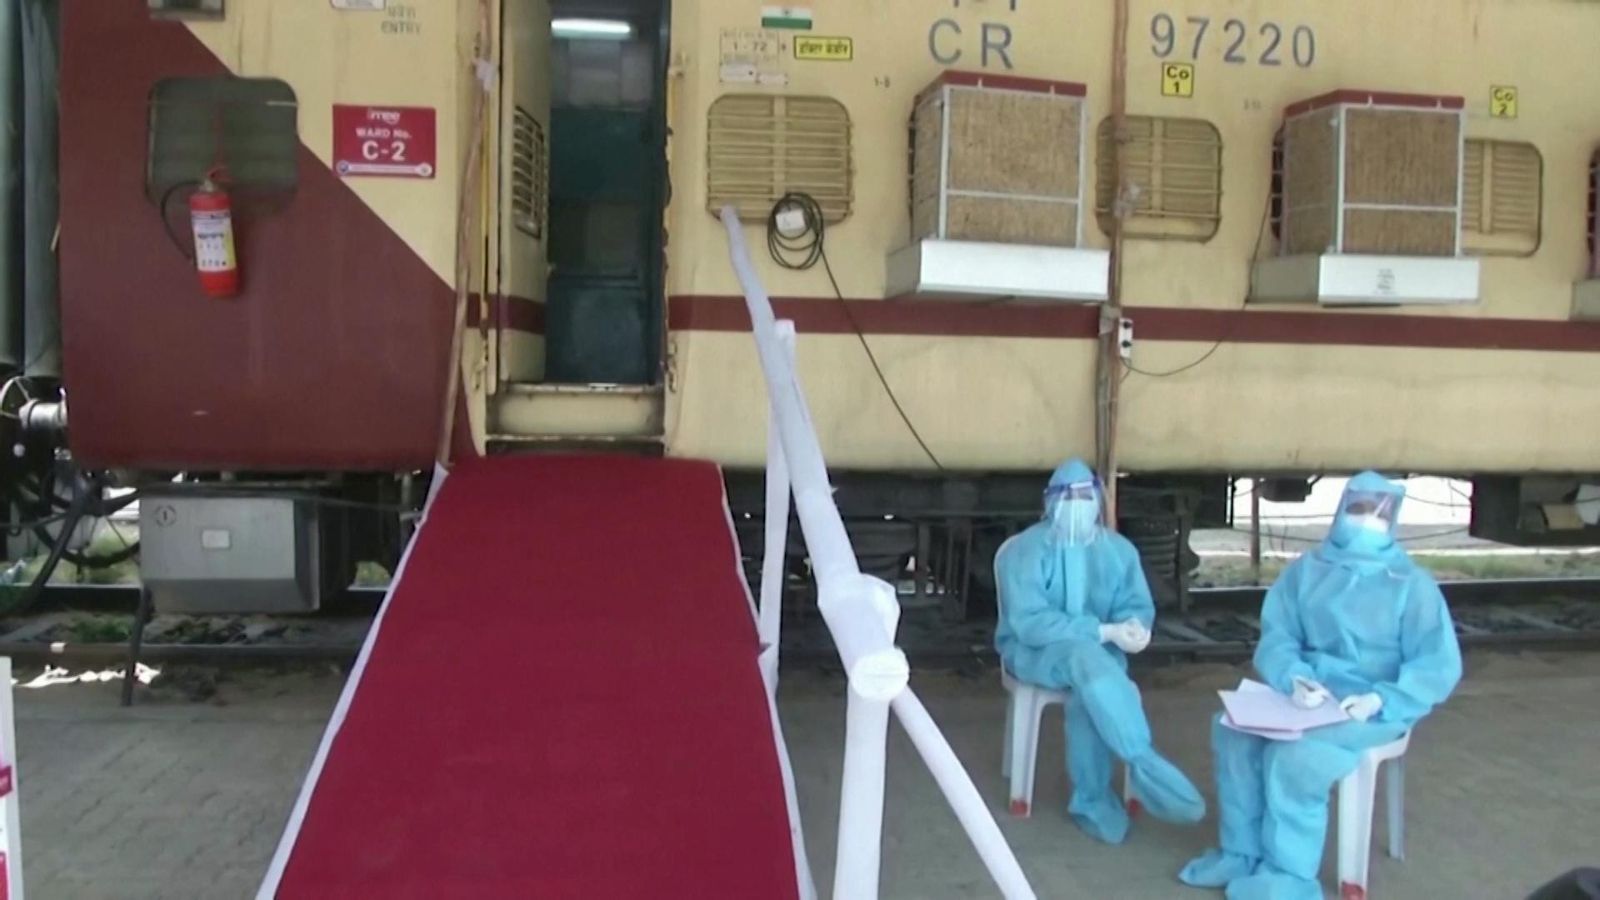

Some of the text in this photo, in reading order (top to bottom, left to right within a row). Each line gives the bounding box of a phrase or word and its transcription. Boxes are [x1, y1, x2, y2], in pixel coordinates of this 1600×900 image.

[1151, 13, 1315, 68] 97220
[1166, 65, 1190, 80] Co
[1172, 81, 1181, 93] 1
[1494, 88, 1514, 102] Co
[355, 127, 391, 138] WARD
[362, 140, 406, 161] C-2
